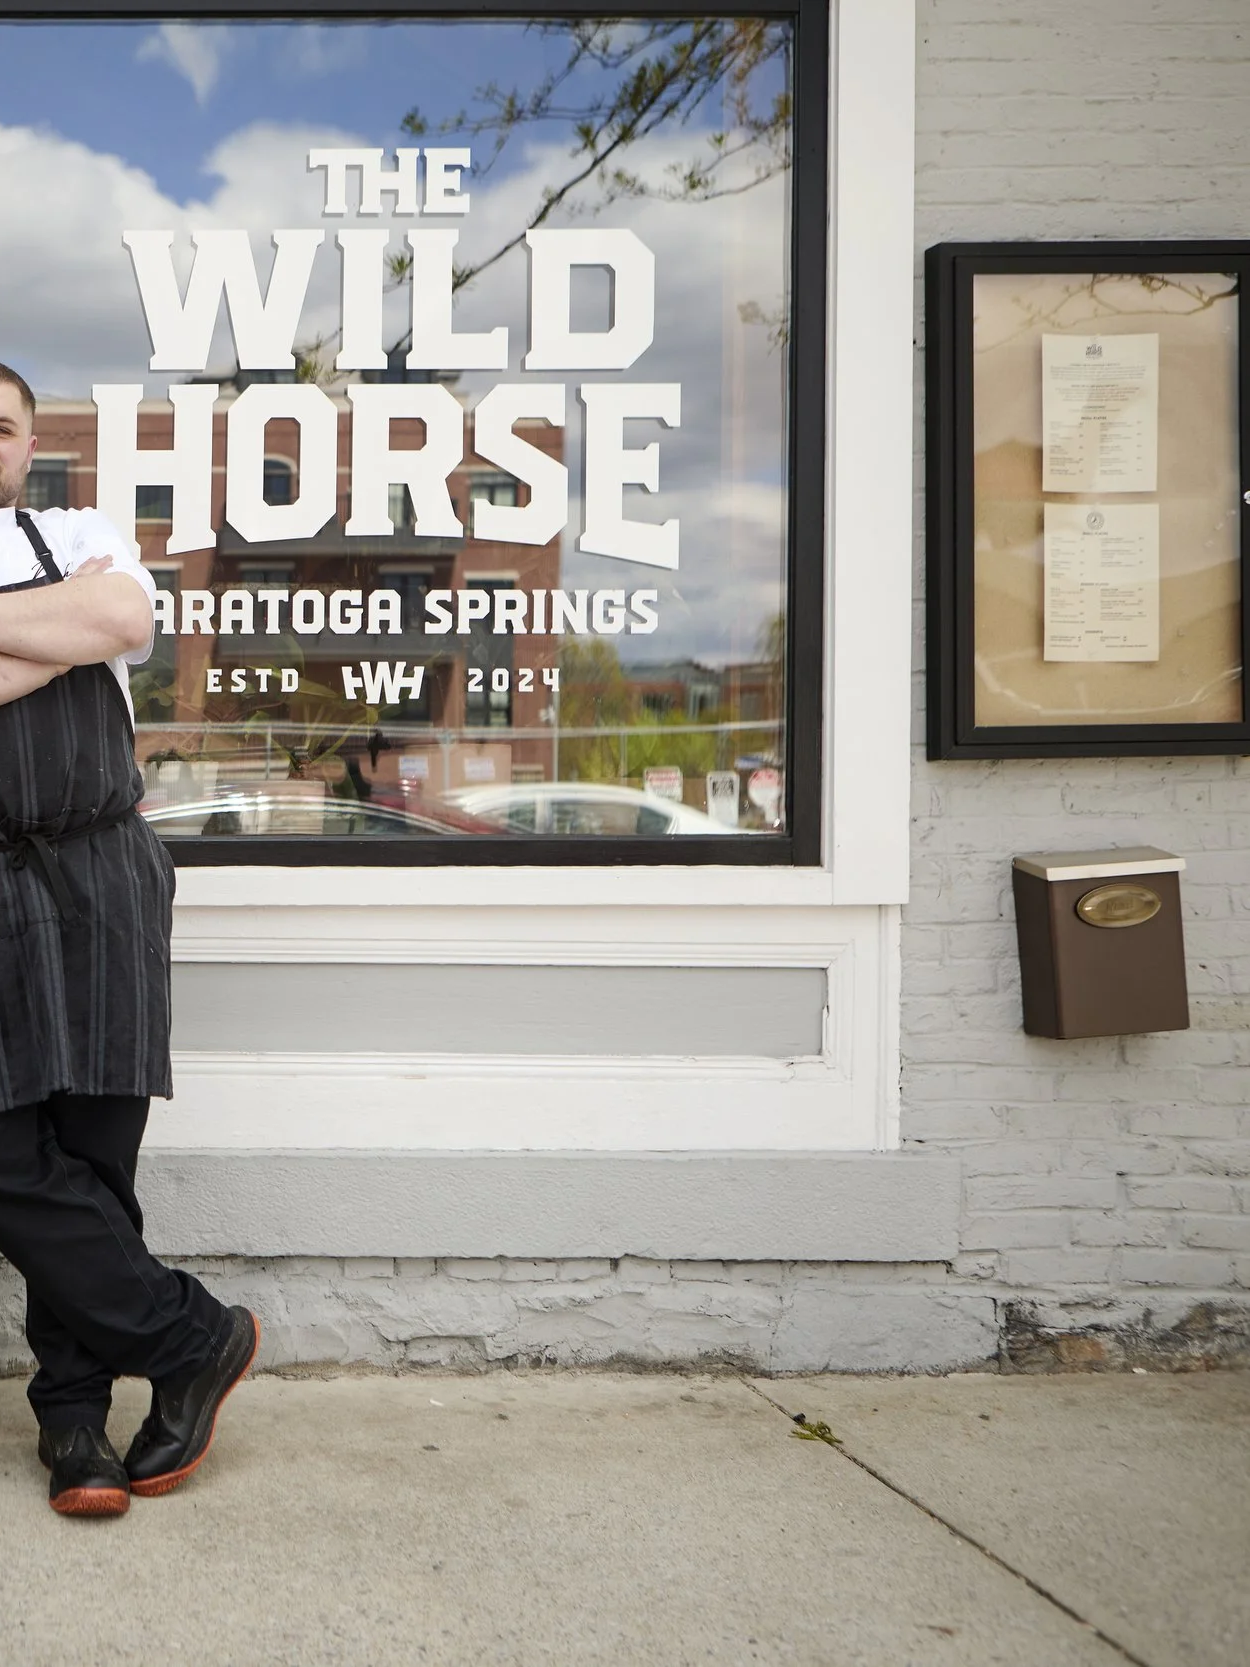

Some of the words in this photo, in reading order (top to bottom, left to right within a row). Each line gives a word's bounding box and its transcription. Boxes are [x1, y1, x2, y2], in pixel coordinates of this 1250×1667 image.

[309, 148, 471, 214] THE
[122, 228, 656, 370] WILD
[91, 383, 681, 570] HORSE
[154, 589, 403, 634] ARATOGA
[424, 589, 659, 634] SPRINGS
[206, 668, 300, 693] ESTD
[467, 668, 560, 692] 2024
